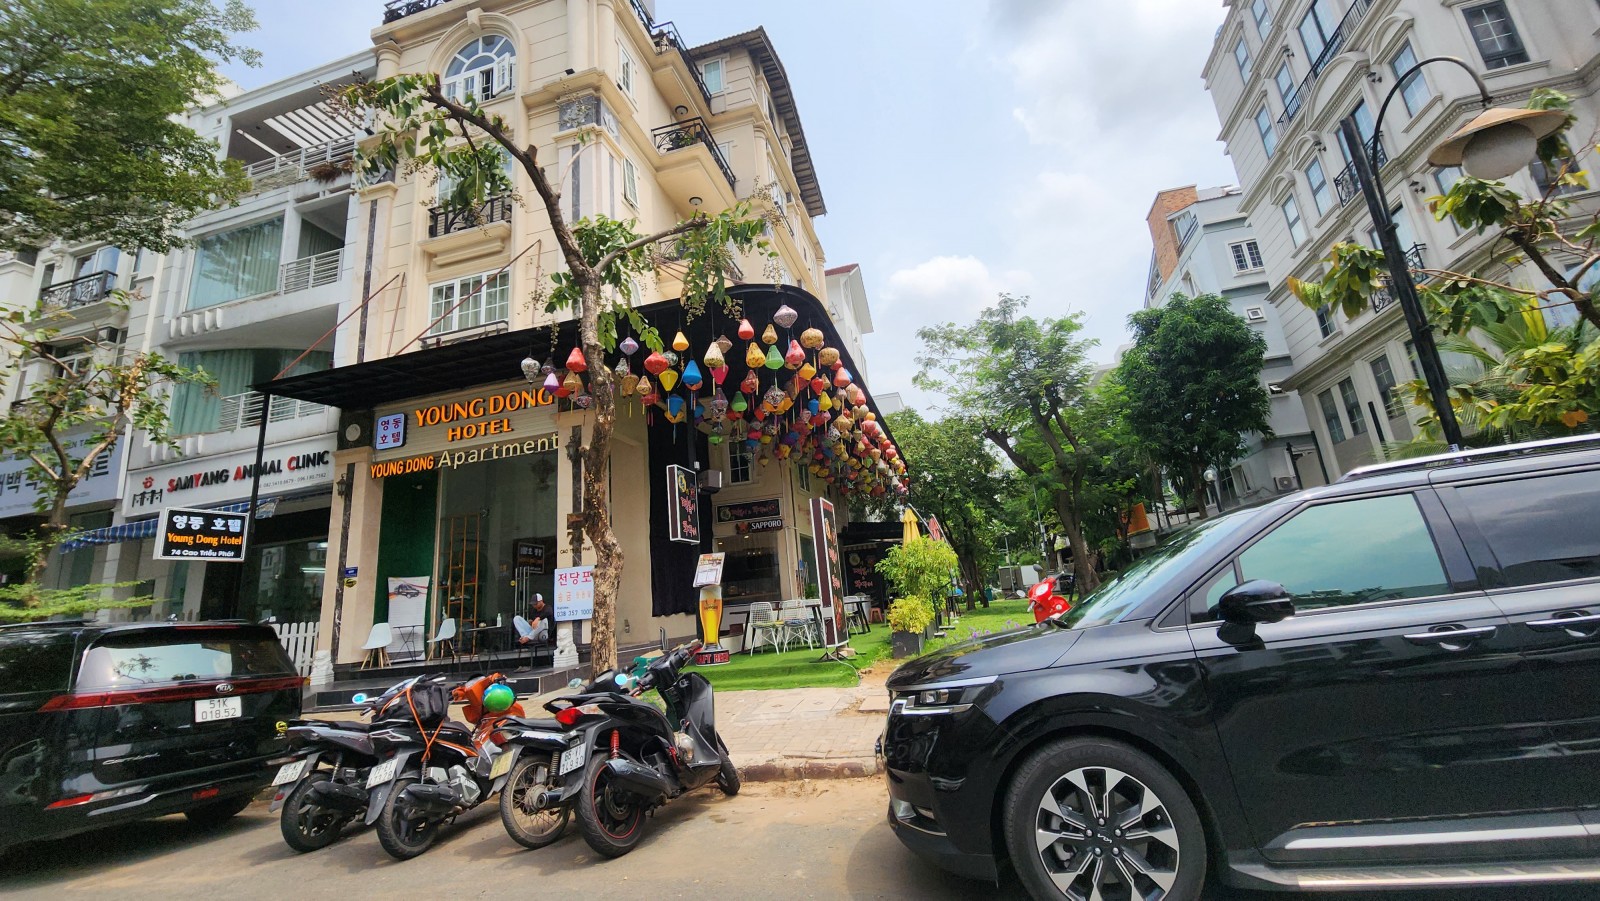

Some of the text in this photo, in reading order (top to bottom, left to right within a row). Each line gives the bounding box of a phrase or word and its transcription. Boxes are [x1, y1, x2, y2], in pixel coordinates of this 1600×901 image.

[415, 387, 553, 427] YOUNG DONG
[380, 417, 402, 431] 영동
[447, 418, 513, 442] HOTEL
[379, 431, 401, 444] 호텔
[370, 430, 559, 479] YOUNG DONG Apartment
[167, 468, 230, 493] SAMYANG
[287, 450, 330, 471] CLINIC
[172, 515, 242, 533] 영동 호텔
[751, 520, 782, 530] SAPPORO
[167, 532, 242, 547] Young Dong Hotel
[209, 699, 228, 709] 51K
[201, 707, 237, 720] 018.52
